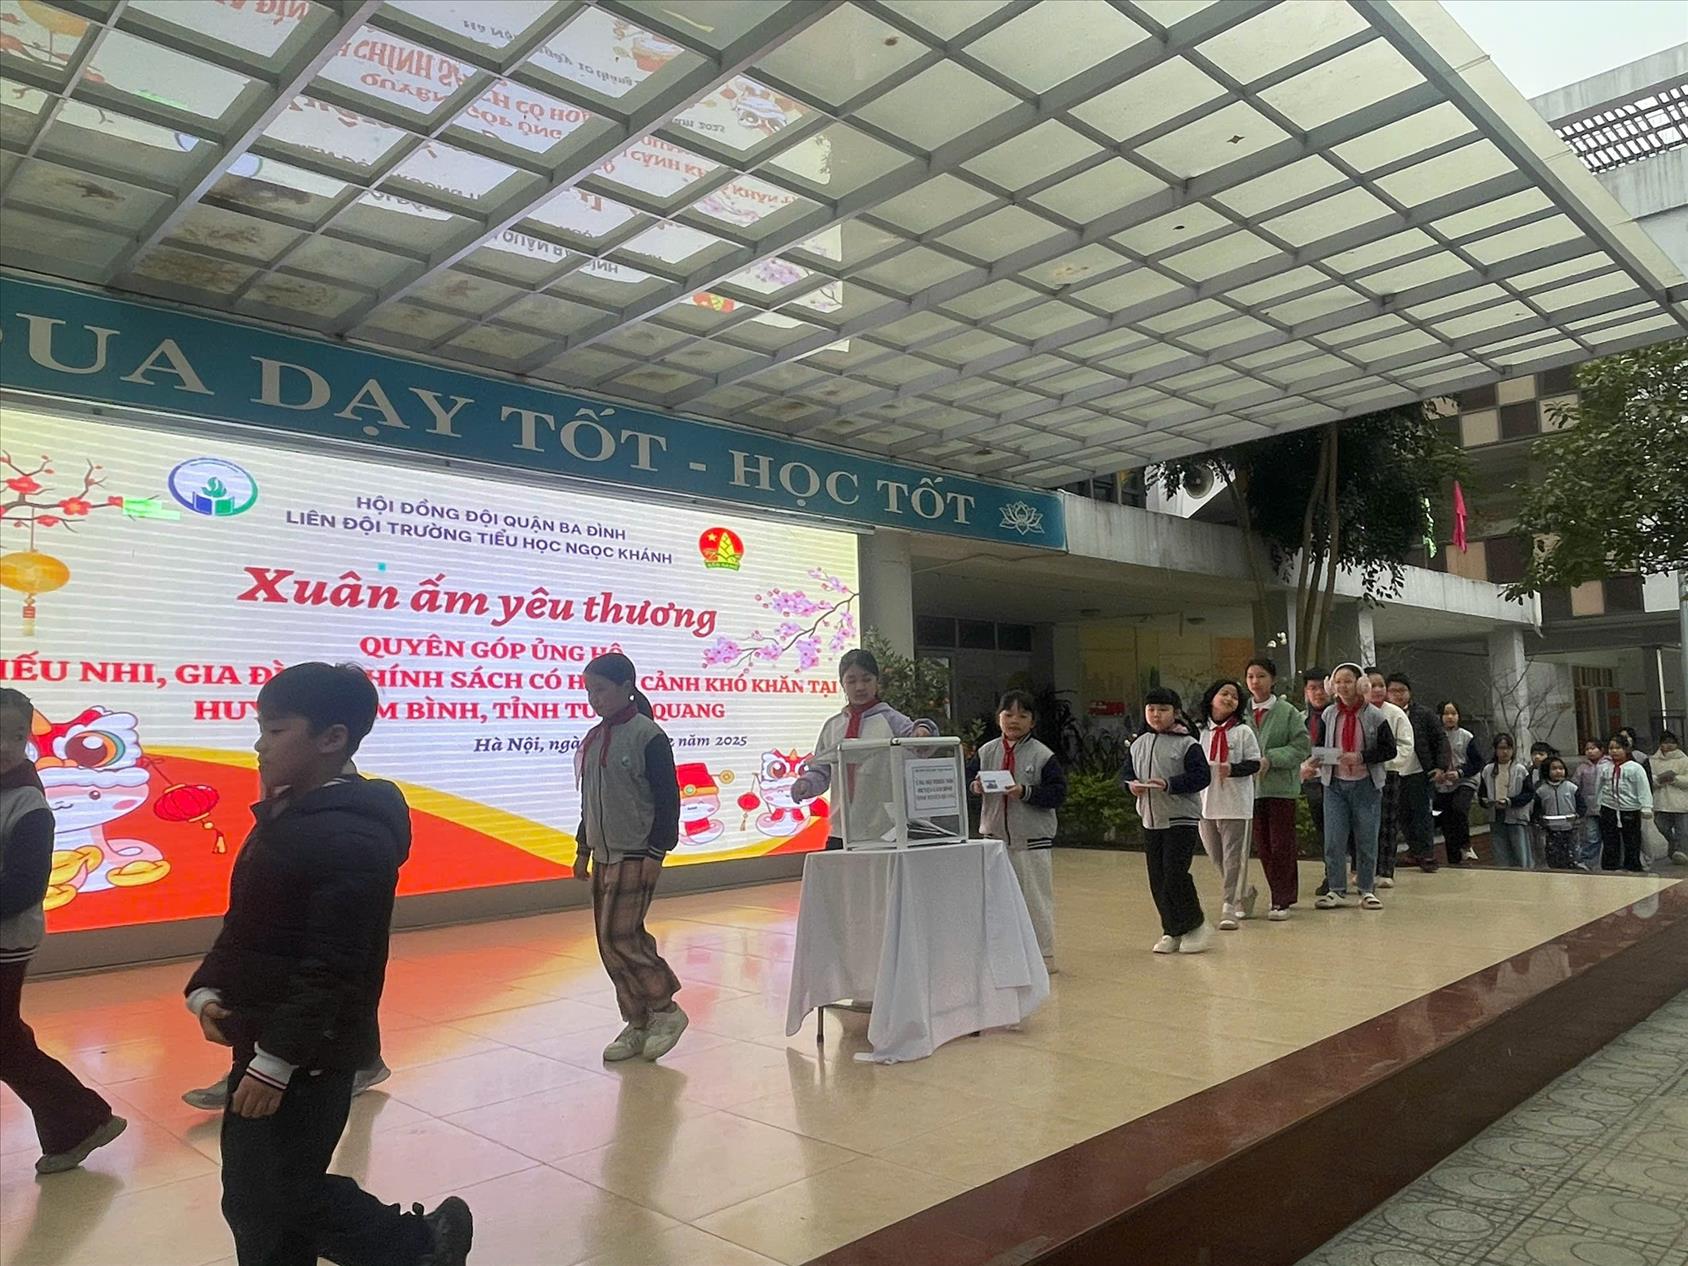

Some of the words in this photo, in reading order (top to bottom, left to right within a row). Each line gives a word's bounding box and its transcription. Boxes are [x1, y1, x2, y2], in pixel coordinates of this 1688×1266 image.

[0, 312, 215, 396] UA
[250, 356, 475, 438] DẠY
[500, 405, 668, 472] TỐT
[729, 449, 860, 507] HỌC
[876, 477, 976, 524] TỐT
[356, 495, 394, 515] HỘI
[400, 498, 460, 520] ĐỒNG
[465, 509, 498, 528] ĐỘI
[503, 515, 555, 534] QUẬN
[559, 522, 582, 535] BA
[586, 523, 626, 541] ĐÌNH
[286, 510, 336, 529] LIÊN
[343, 516, 381, 536] ĐỘI
[387, 522, 473, 543] TRƯỜNG
[477, 528, 518, 547] TIỂU
[523, 537, 561, 554] HỌC
[566, 542, 614, 560] NGỌC
[618, 547, 672, 565] KHÁNH
[237, 566, 400, 610] Xuân
[410, 573, 489, 616] ấm
[490, 586, 575, 627] yêu
[583, 591, 717, 638] thương
[359, 634, 465, 659] QUYÊN
[471, 637, 526, 659] GÓP
[531, 638, 585, 662] ỦNG
[79, 661, 167, 689] NHI,
[175, 664, 241, 685] GIA
[364, 663, 443, 688] HÍNH
[450, 666, 523, 689] SÁCH
[529, 668, 562, 690] CÓ
[641, 671, 700, 692] CẢNH
[706, 674, 747, 692] KHÓ
[752, 675, 804, 694] KHĂN
[808, 680, 837, 698] TẠI
[406, 696, 489, 724] BÌNH,
[493, 696, 560, 719] TỈNH
[653, 703, 725, 720] QUANG
[474, 738, 503, 753] Hà
[507, 738, 545, 755] Nội,
[679, 735, 710, 747] năm
[715, 736, 748, 746] 2025
